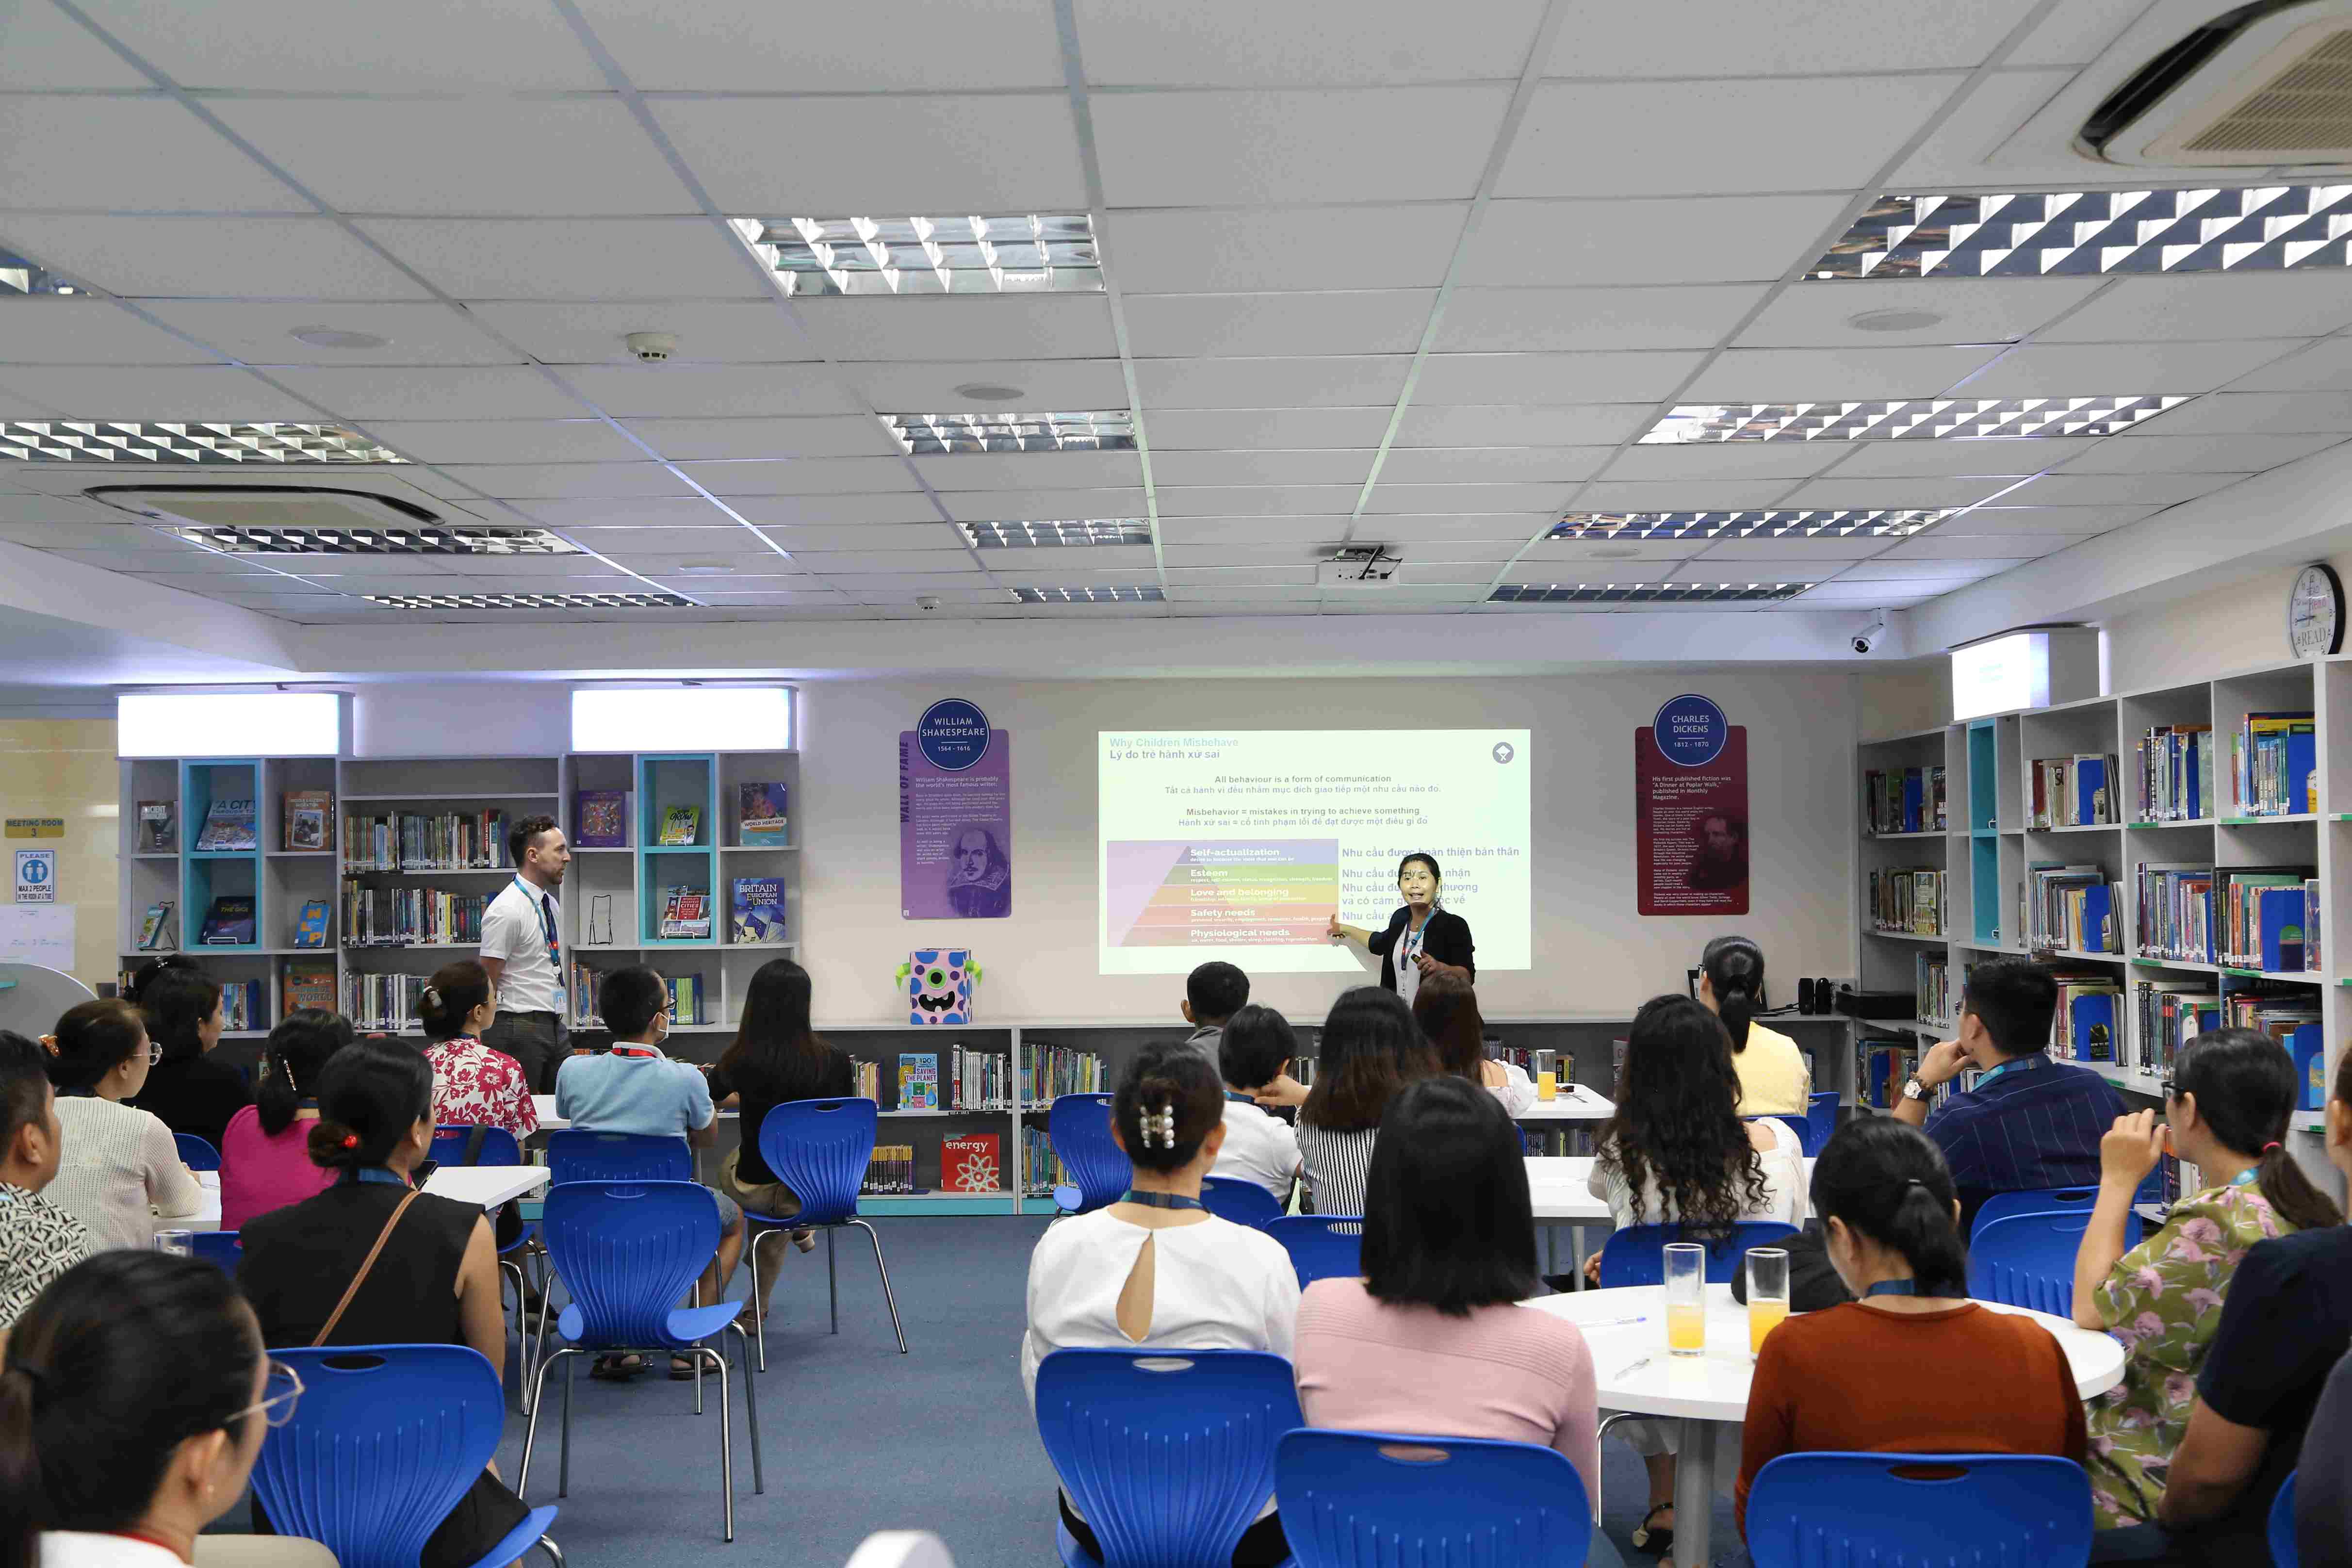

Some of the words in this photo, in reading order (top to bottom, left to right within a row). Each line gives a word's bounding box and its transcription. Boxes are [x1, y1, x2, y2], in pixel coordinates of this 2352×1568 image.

[2302, 628, 2326, 646] READ
[934, 718, 973, 726] WILLIAM
[922, 728, 985, 736] SHAKESPEARE
[1110, 737, 1132, 749] Why
[1136, 737, 1180, 747] Children
[1184, 737, 1239, 747] Misbehave
[900, 741, 909, 771] FAME
[1111, 750, 1122, 760] Lý
[1126, 750, 1138, 758] do
[1160, 750, 1184, 758] hành
[900, 775, 909, 789] OF
[1315, 785, 1333, 795] giao
[900, 794, 909, 823] WALL
[32, 828, 37, 837] 3
[1342, 849, 1362, 857] Nhu
[739, 884, 777, 893] BRITAIN
[747, 893, 777, 901] EUROPEAN
[1238, 889, 1289, 898] belonging
[1191, 909, 1223, 918] Safety
[1225, 909, 1255, 917] needs
[1191, 929, 1257, 938] Physiological
[946, 1141, 988, 1153] energy
